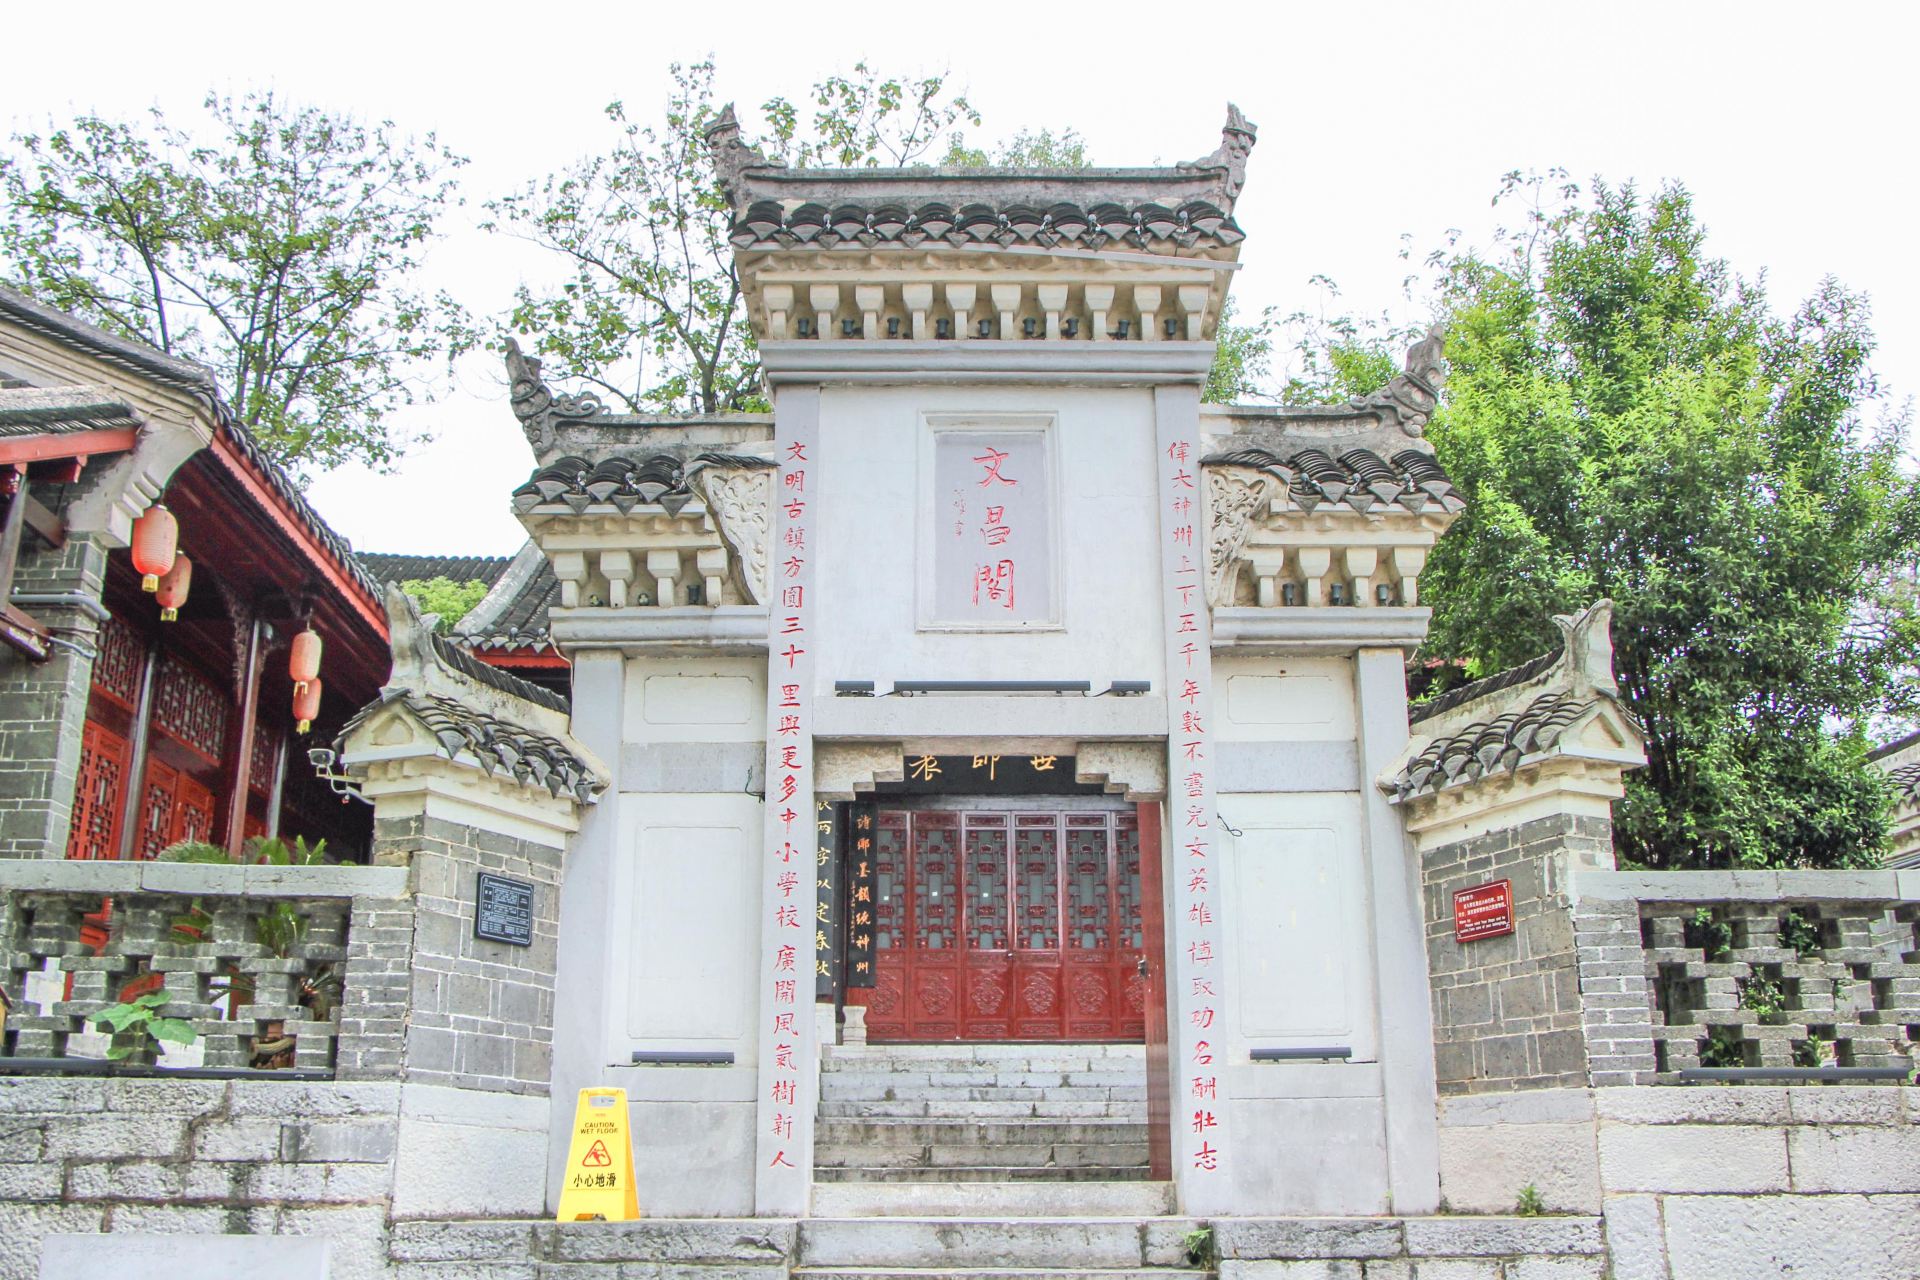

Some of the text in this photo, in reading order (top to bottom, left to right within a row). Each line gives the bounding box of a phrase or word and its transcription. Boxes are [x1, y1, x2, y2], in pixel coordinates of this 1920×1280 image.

[971, 446, 1019, 611] 文昌閣
[573, 1173, 617, 1188] 小心地滑
